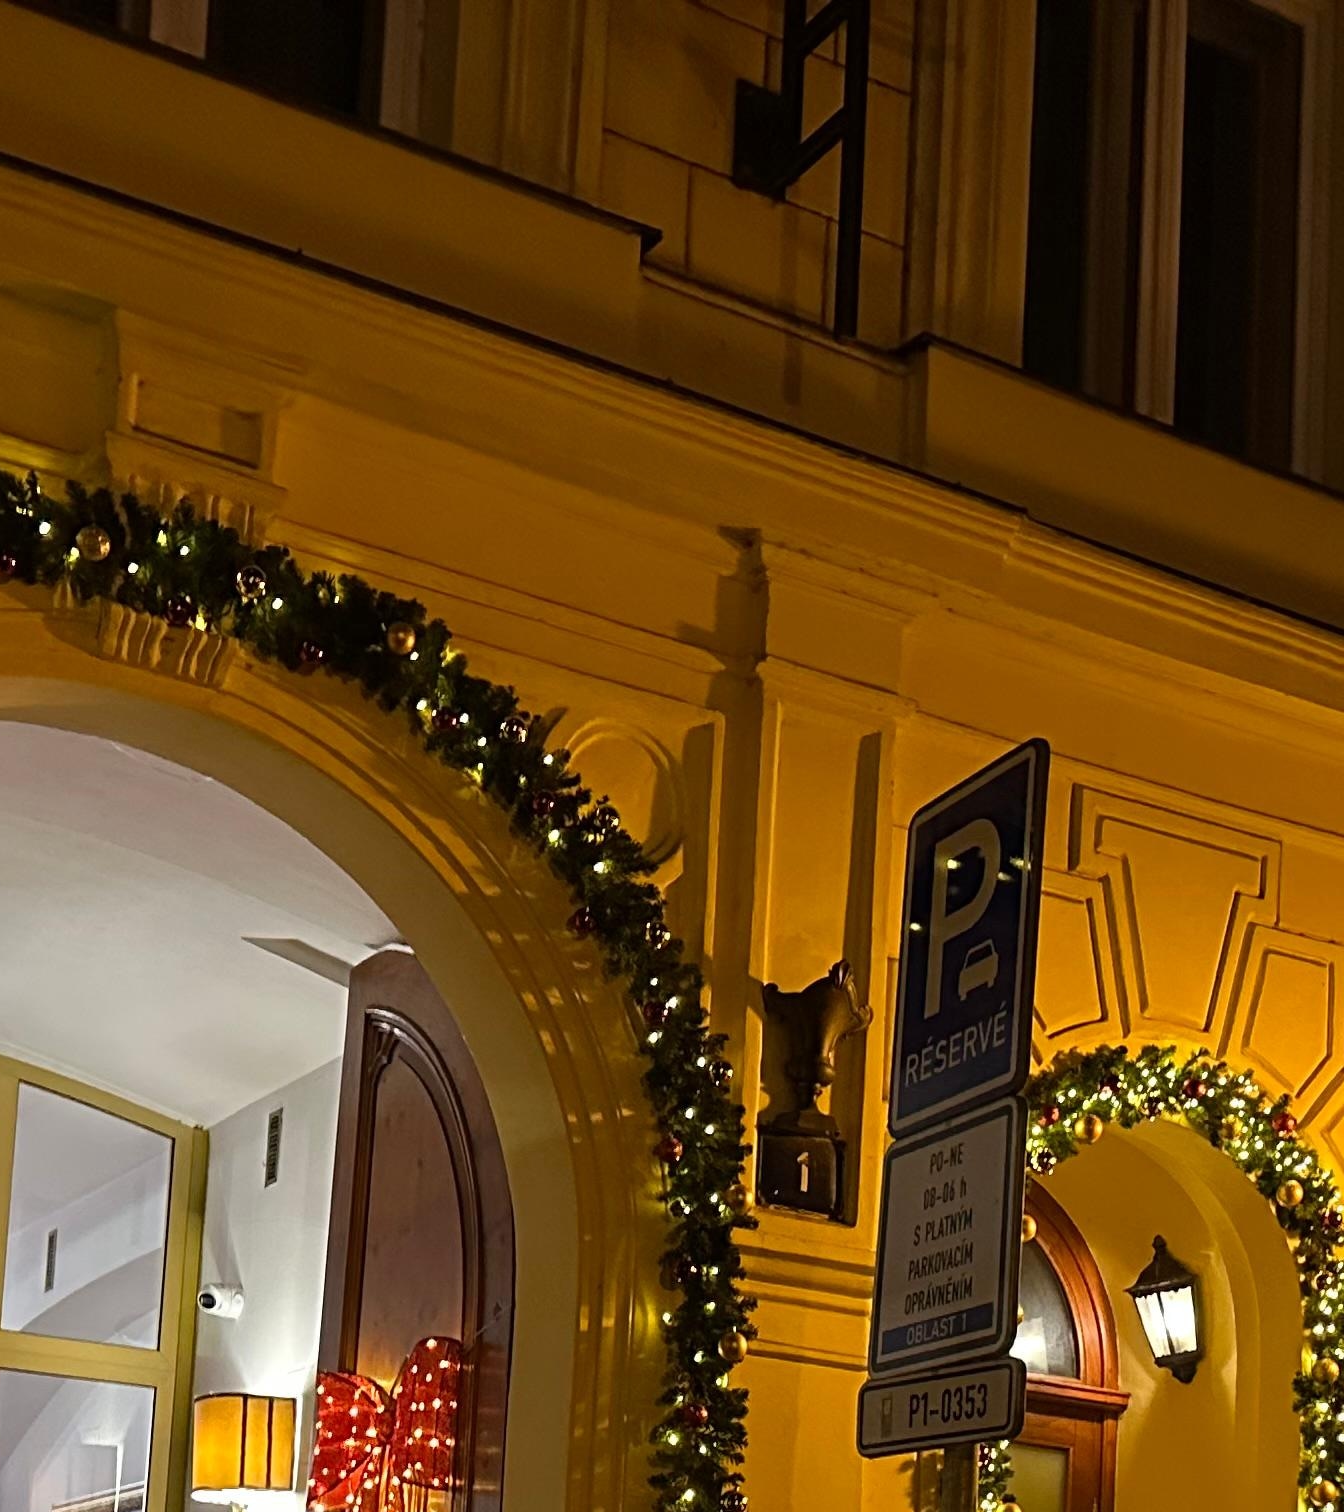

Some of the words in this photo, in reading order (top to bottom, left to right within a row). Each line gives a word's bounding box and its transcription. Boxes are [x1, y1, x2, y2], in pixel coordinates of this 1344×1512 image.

[924, 818, 1001, 1019] P
[904, 1001, 1007, 1087] RÉSERVÉ
[929, 1142, 964, 1175] PO-NE
[959, 1175, 967, 1199] h
[913, 1224, 920, 1247] S
[925, 1206, 973, 1243] PLATNÝM
[908, 1240, 973, 1282] PARKOVACÍM
[904, 1275, 973, 1316] OPRÁVNĚNÍM
[906, 1319, 955, 1346] OBLAST
[961, 1315, 967, 1333] 1
[909, 1382, 989, 1428] P1-0353
